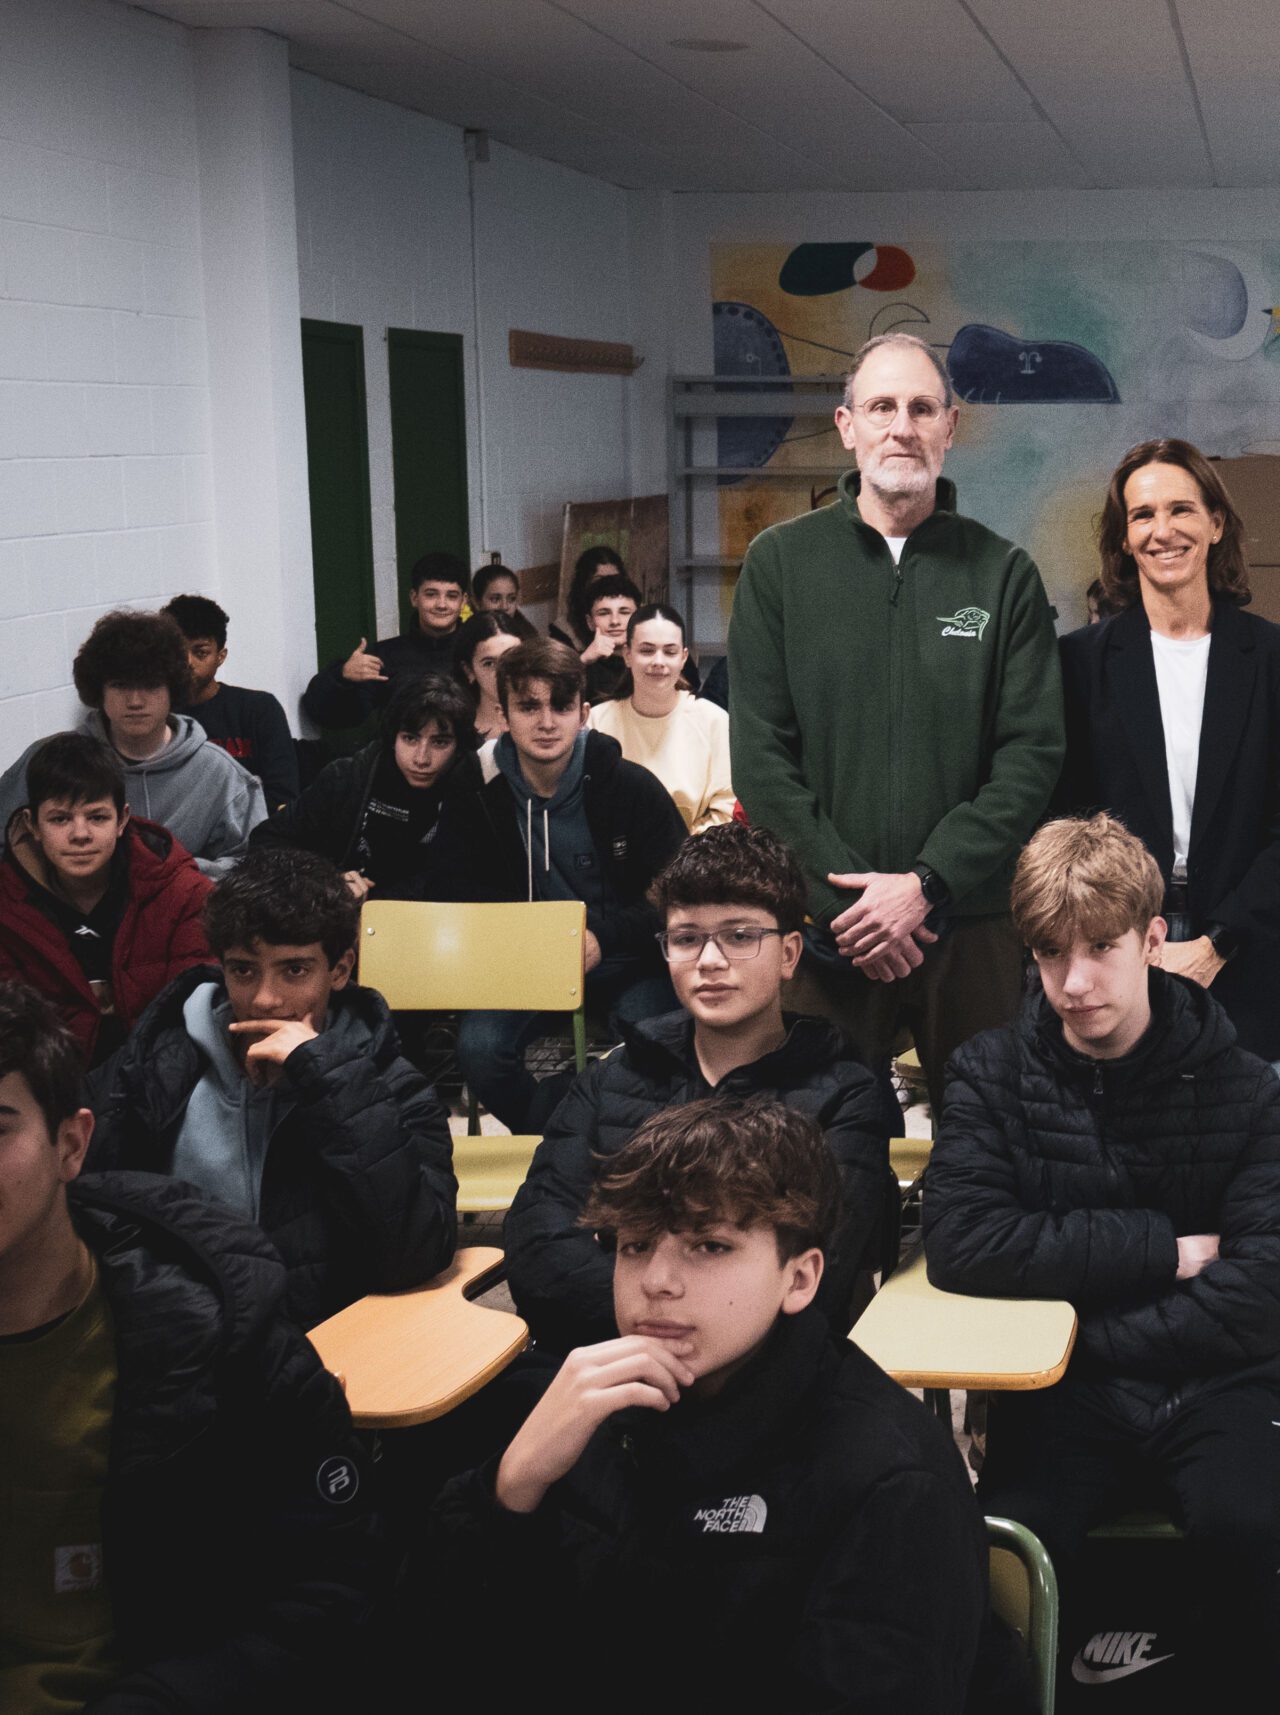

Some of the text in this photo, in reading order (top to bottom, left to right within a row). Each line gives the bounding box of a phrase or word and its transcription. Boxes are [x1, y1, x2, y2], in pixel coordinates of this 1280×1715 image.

[722, 1495, 751, 1508] THE
[694, 1507, 746, 1520] NORTH
[702, 1519, 741, 1533] FACE
[1083, 1631, 1158, 1665] NIKE
